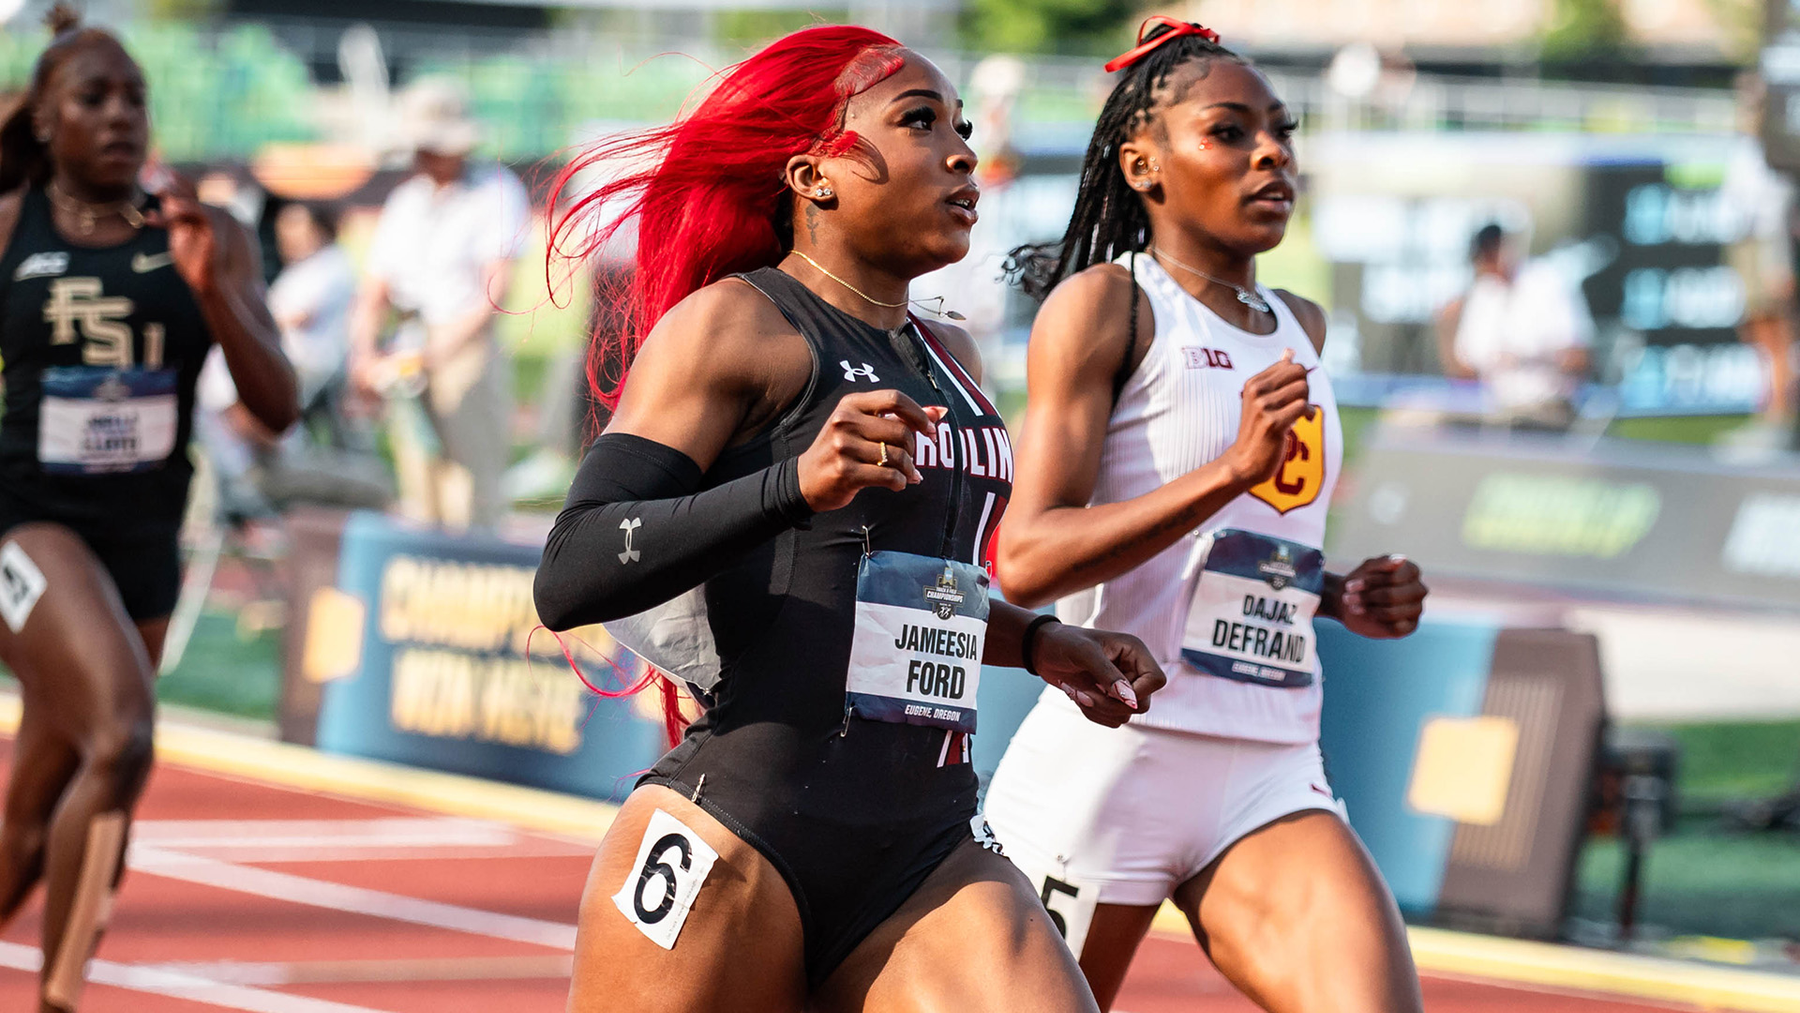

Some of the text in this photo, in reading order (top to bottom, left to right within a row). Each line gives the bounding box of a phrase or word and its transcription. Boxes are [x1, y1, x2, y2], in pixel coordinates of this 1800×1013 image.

[895, 624, 977, 660] JAMEESIA
[1212, 619, 1305, 663] DEFRAND
[906, 659, 966, 699] FORD
[933, 708, 961, 722] OREGON
[634, 832, 693, 924] 6
